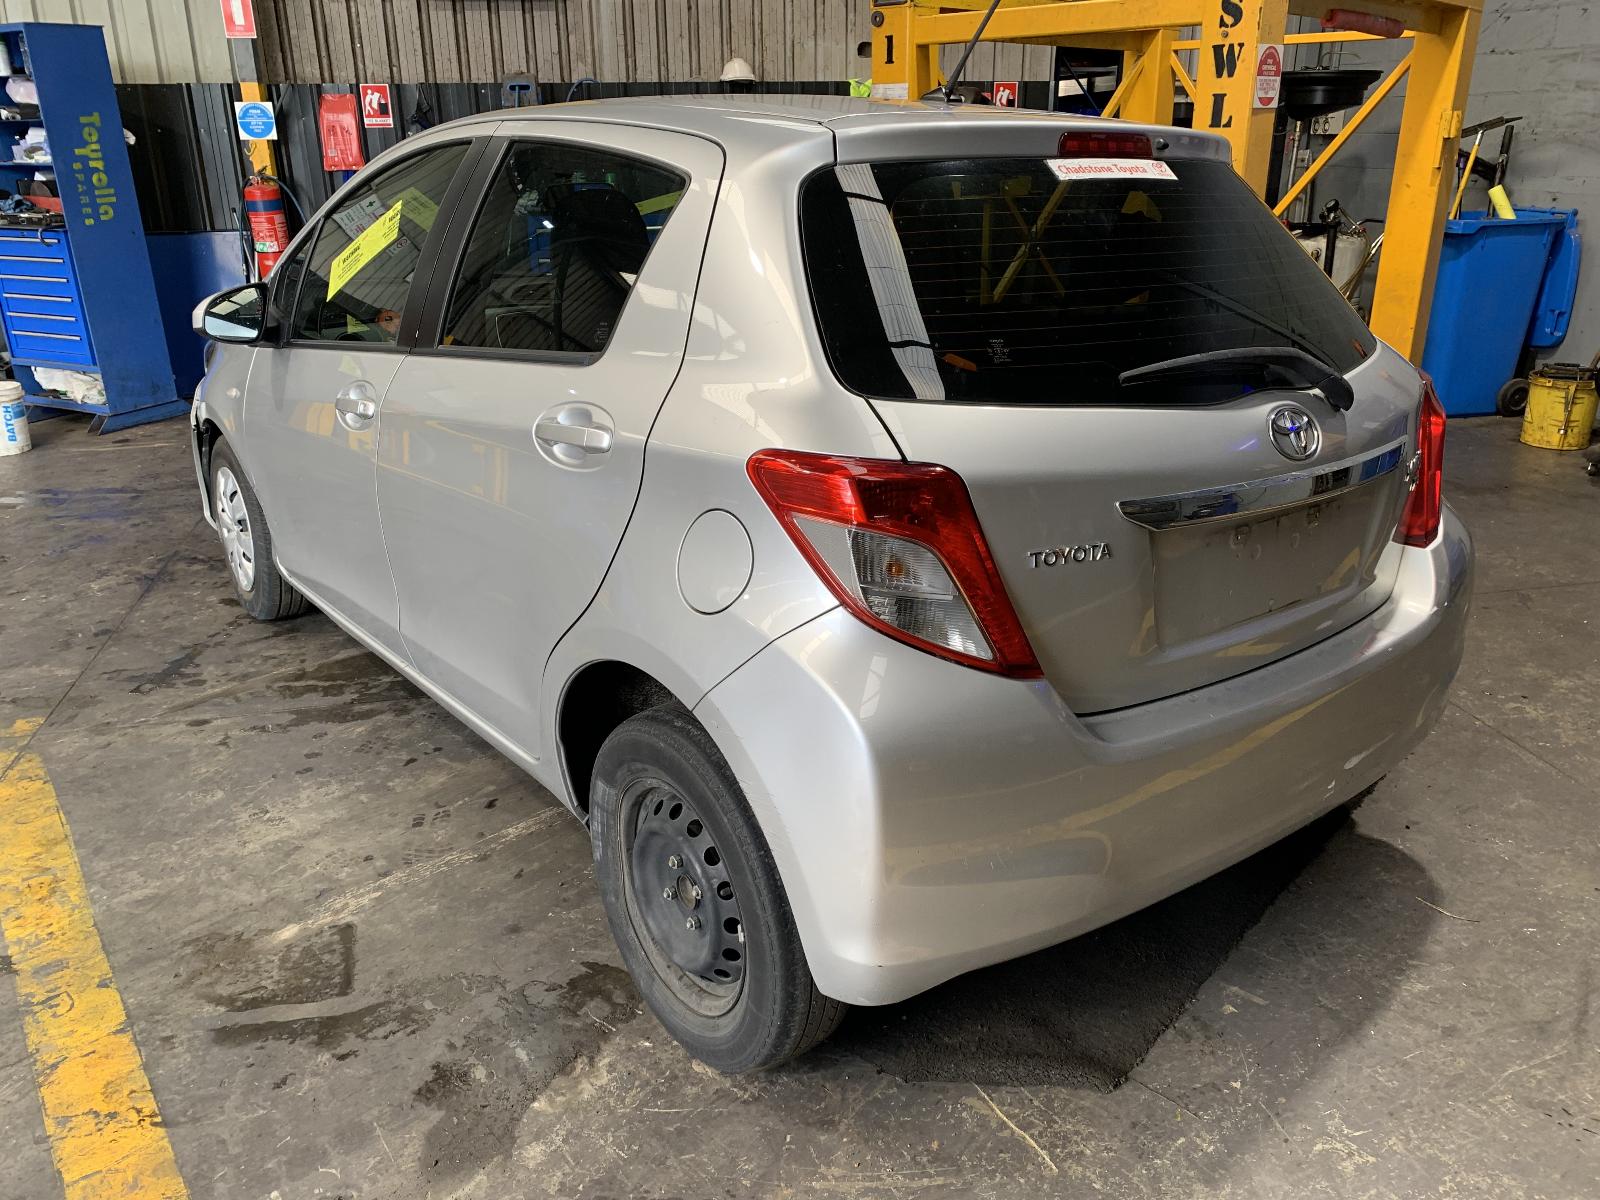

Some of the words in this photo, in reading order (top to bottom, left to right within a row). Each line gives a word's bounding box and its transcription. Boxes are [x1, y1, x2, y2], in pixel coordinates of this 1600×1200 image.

[885, 35, 894, 64] 1
[1057, 163, 1114, 175] Chadstone
[1112, 163, 1148, 175] Toyota
[72, 162, 95, 226] SPARES
[2, 405, 17, 442] BATCH
[1027, 542, 1112, 569] TOYOTA
